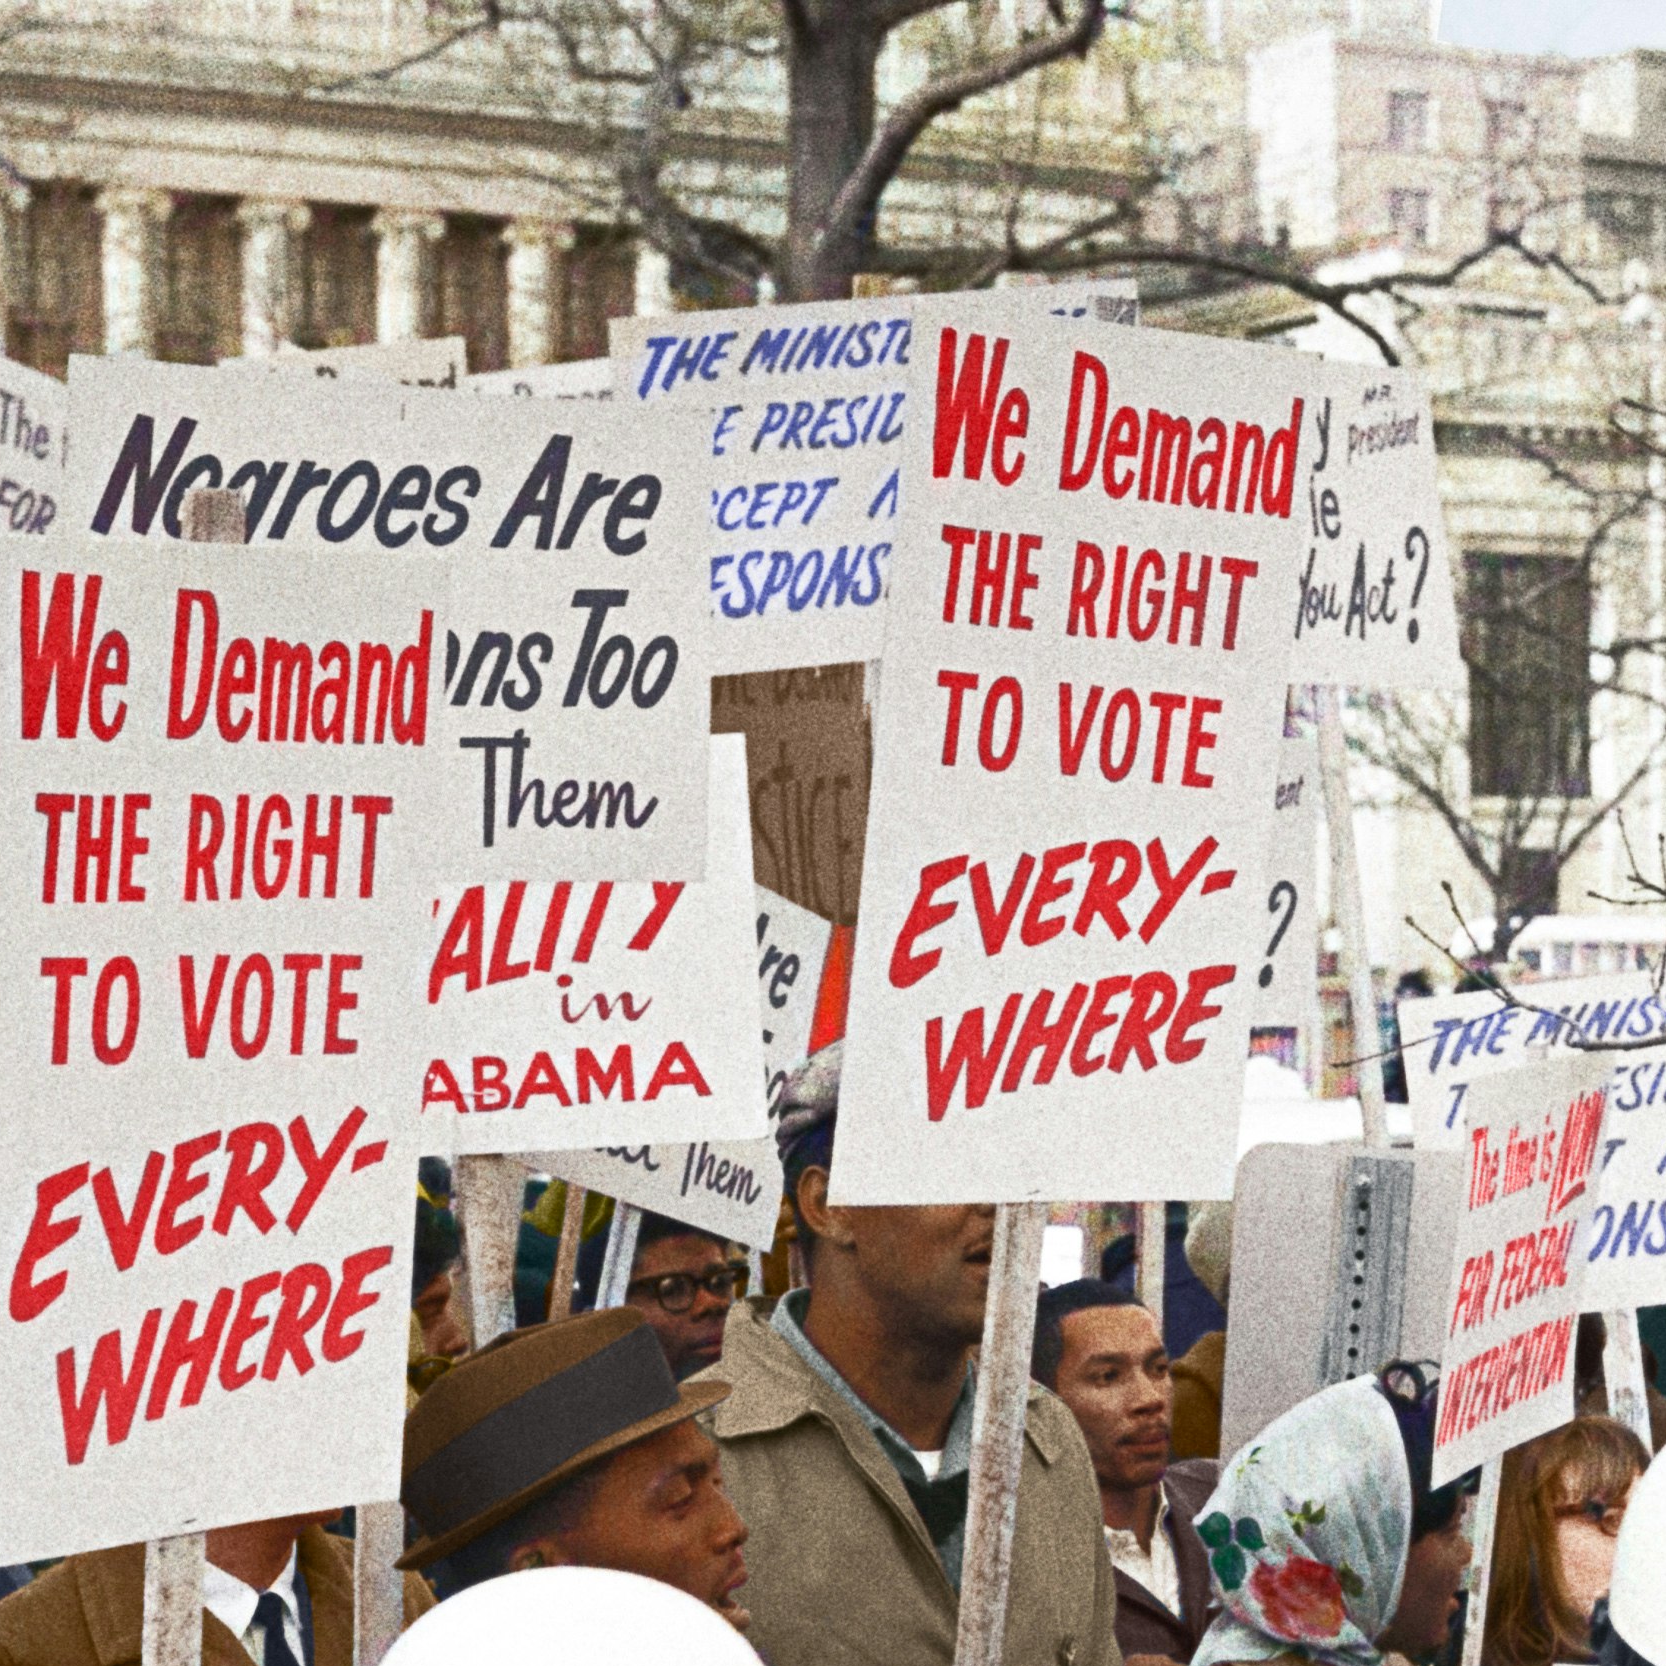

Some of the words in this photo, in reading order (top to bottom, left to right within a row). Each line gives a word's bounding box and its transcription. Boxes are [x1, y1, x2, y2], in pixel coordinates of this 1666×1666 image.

[637, 332, 739, 400] THE
[933, 326, 1029, 486] We
[1058, 351, 1304, 520] Demand
[491, 433, 663, 555] Are
[711, 477, 839, 532] CEPT
[941, 525, 1044, 632] THE
[1065, 541, 1259, 652] RIGHT
[1294, 547, 1342, 640] You
[20, 568, 129, 740] We
[166, 588, 434, 746] Demand
[445, 628, 553, 708] ns
[562, 588, 678, 711] Too
[459, 727, 659, 848] Them
[937, 669, 1023, 774] TO
[1058, 681, 1223, 790] VOTE
[35, 792, 151, 904] THE
[184, 791, 394, 904] RIGHT
[756, 911, 802, 1010] re
[889, 834, 1238, 990] EVERY-
[39, 955, 140, 1066] TO
[178, 952, 364, 1061] VOTE
[556, 974, 653, 1024] in
[925, 964, 1237, 1123] WHERE
[1429, 1008, 1521, 1075] THE
[9, 1105, 390, 1324] EVERY-
[1469, 1126, 1500, 1213] The
[1502, 1121, 1538, 1198] time
[1450, 1249, 1495, 1341] FOR
[1491, 1219, 1577, 1321] FEDERAL
[55, 1244, 395, 1467] WHERE
[1436, 1311, 1575, 1449] INTERVENTION
